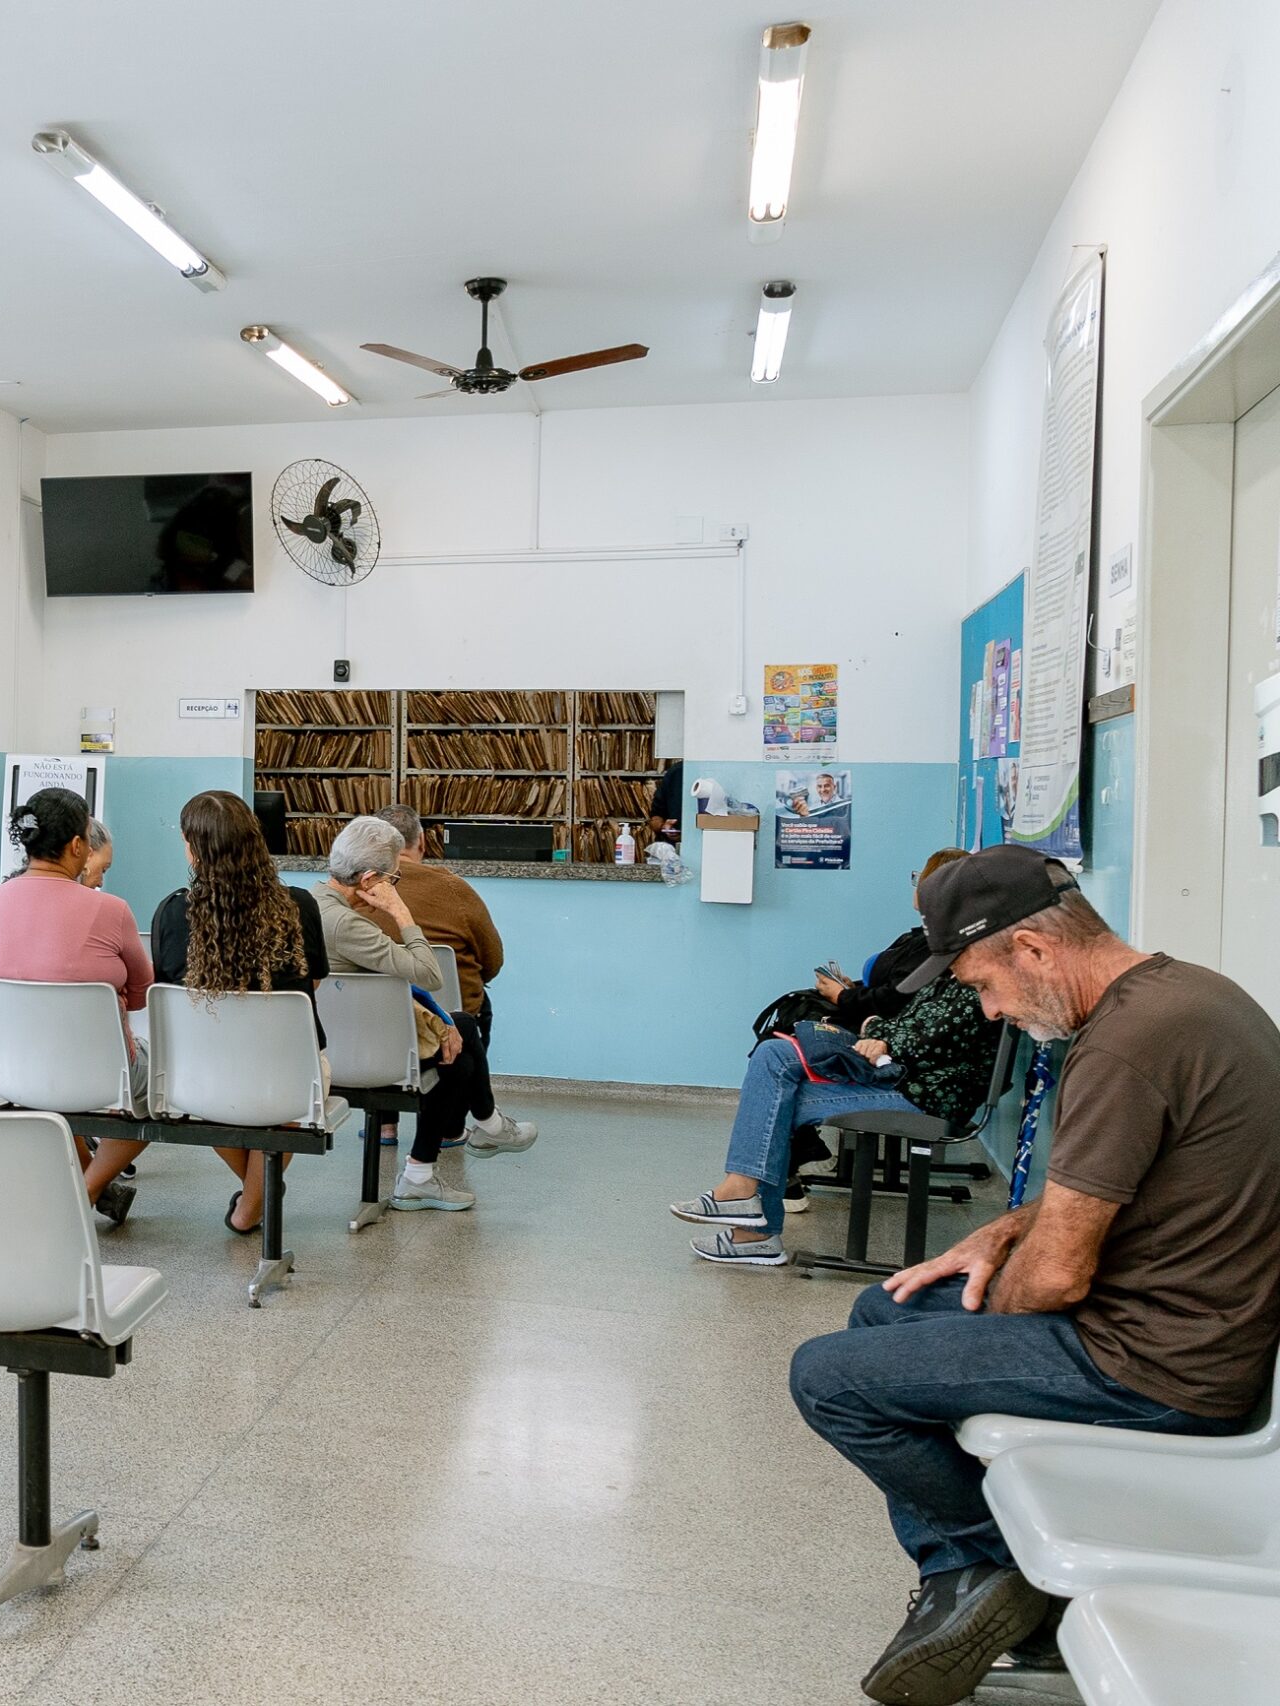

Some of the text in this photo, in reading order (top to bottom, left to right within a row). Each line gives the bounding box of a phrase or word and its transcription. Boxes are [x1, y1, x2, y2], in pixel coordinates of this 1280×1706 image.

[33, 762, 73, 771] NÃO ESTÁ
[23, 771, 83, 780] FUNCIONANDO
